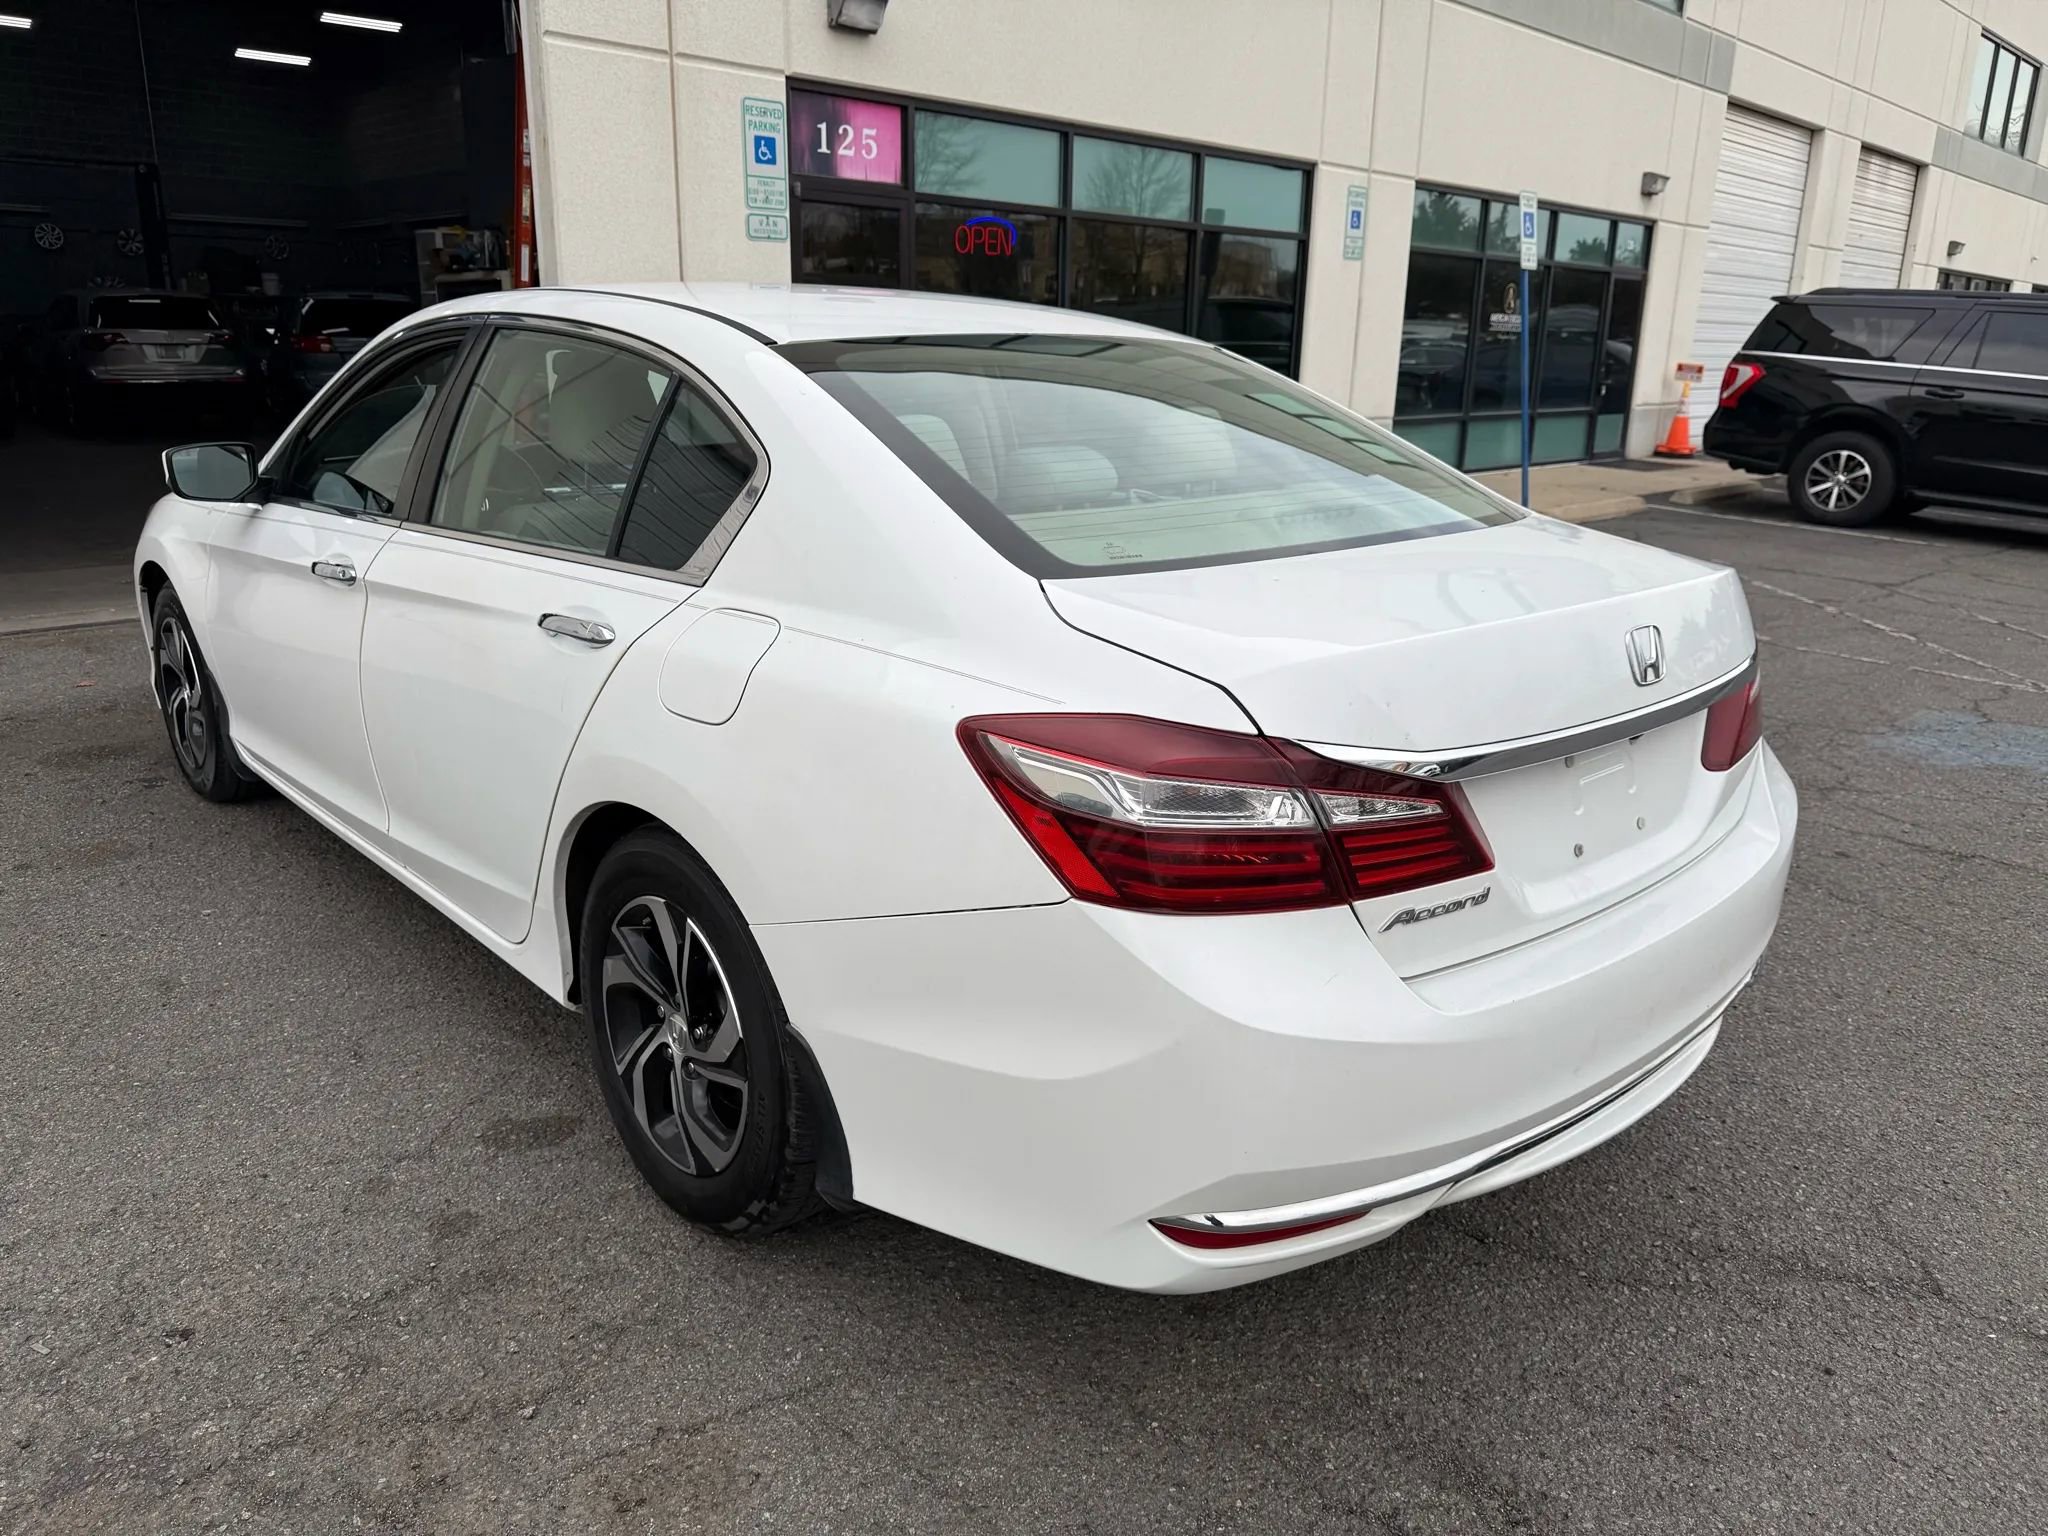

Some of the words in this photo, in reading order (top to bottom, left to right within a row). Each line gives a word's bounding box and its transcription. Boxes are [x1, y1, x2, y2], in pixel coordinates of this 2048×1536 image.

[745, 103, 783, 120] RESERVED
[748, 119, 781, 134] PARKING
[816, 121, 878, 159] 125
[758, 218, 778, 229] VAN
[954, 224, 1013, 257] OPEN
[1378, 883, 1491, 933] Accord
